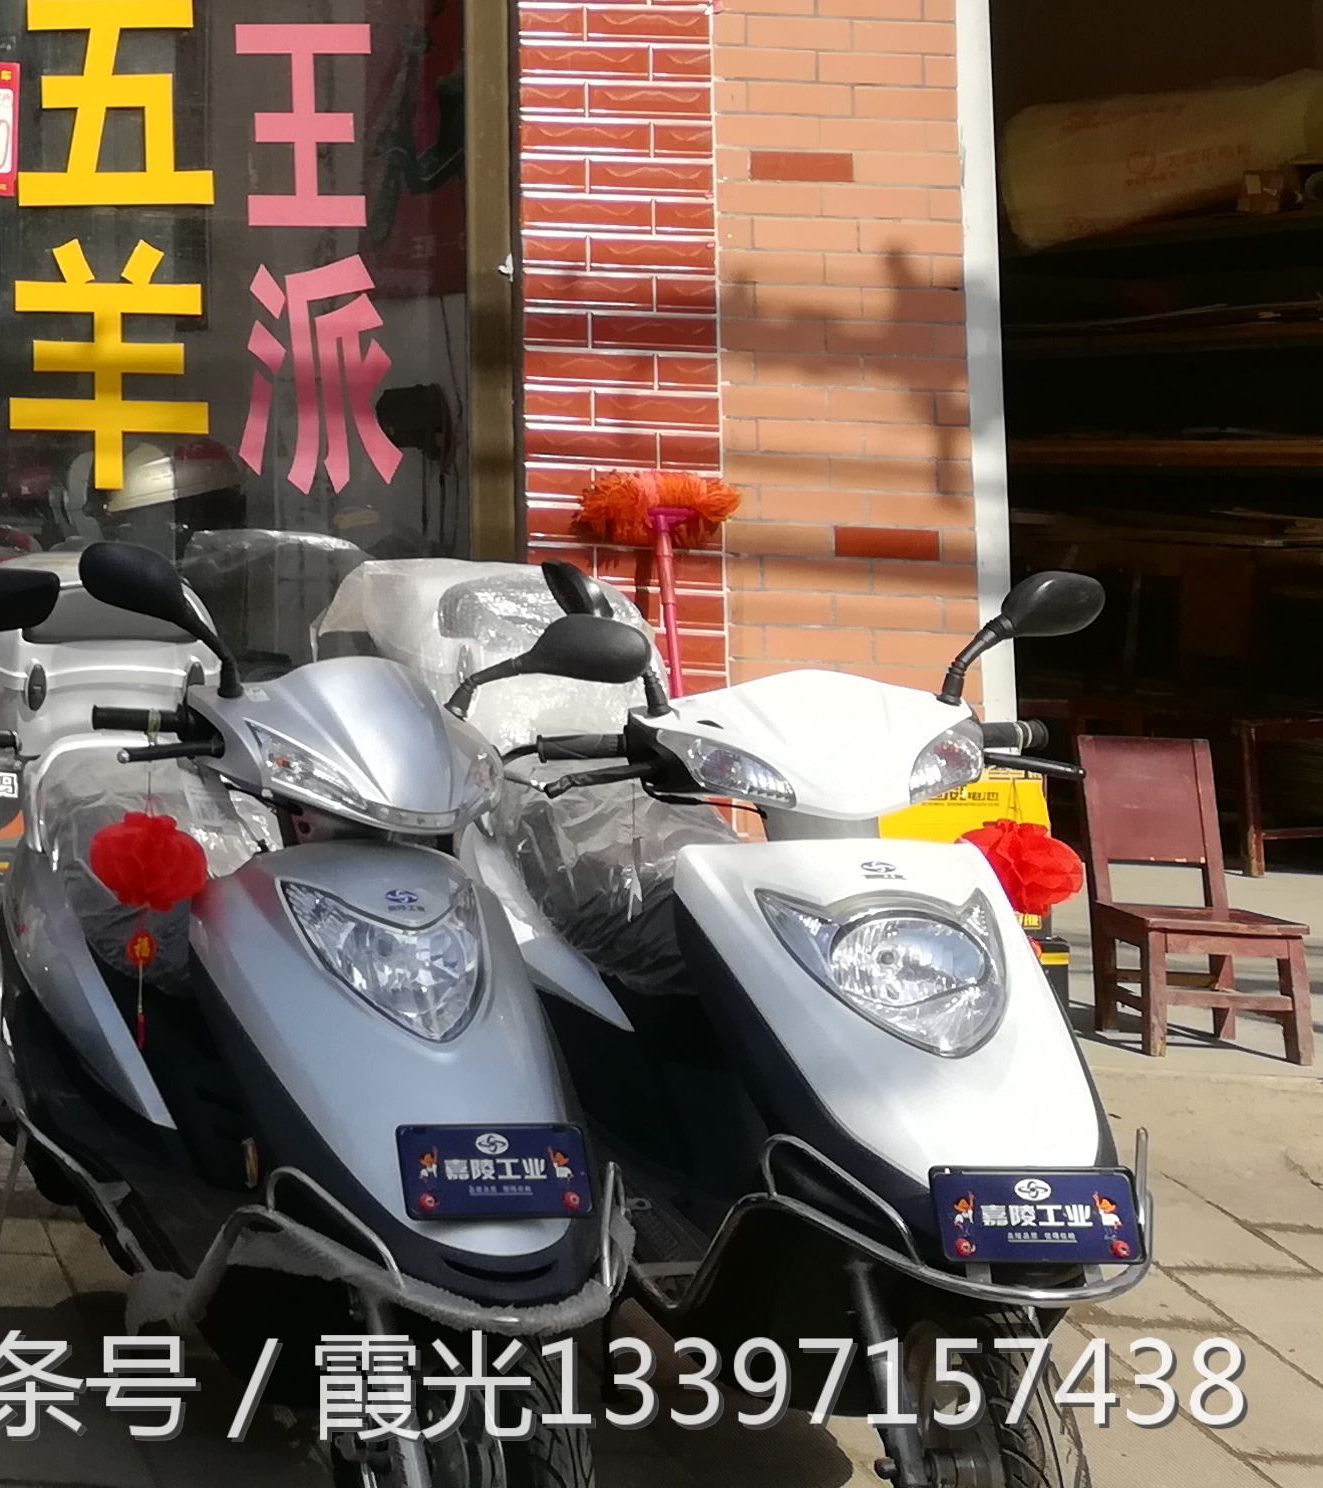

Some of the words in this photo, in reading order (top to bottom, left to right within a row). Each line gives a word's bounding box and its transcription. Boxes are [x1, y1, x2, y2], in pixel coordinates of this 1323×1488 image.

[235, 23, 403, 495] 王派
[444, 1158, 547, 1180] 嘉陵工业
[980, 1204, 1093, 1227] 嘉陵工业
